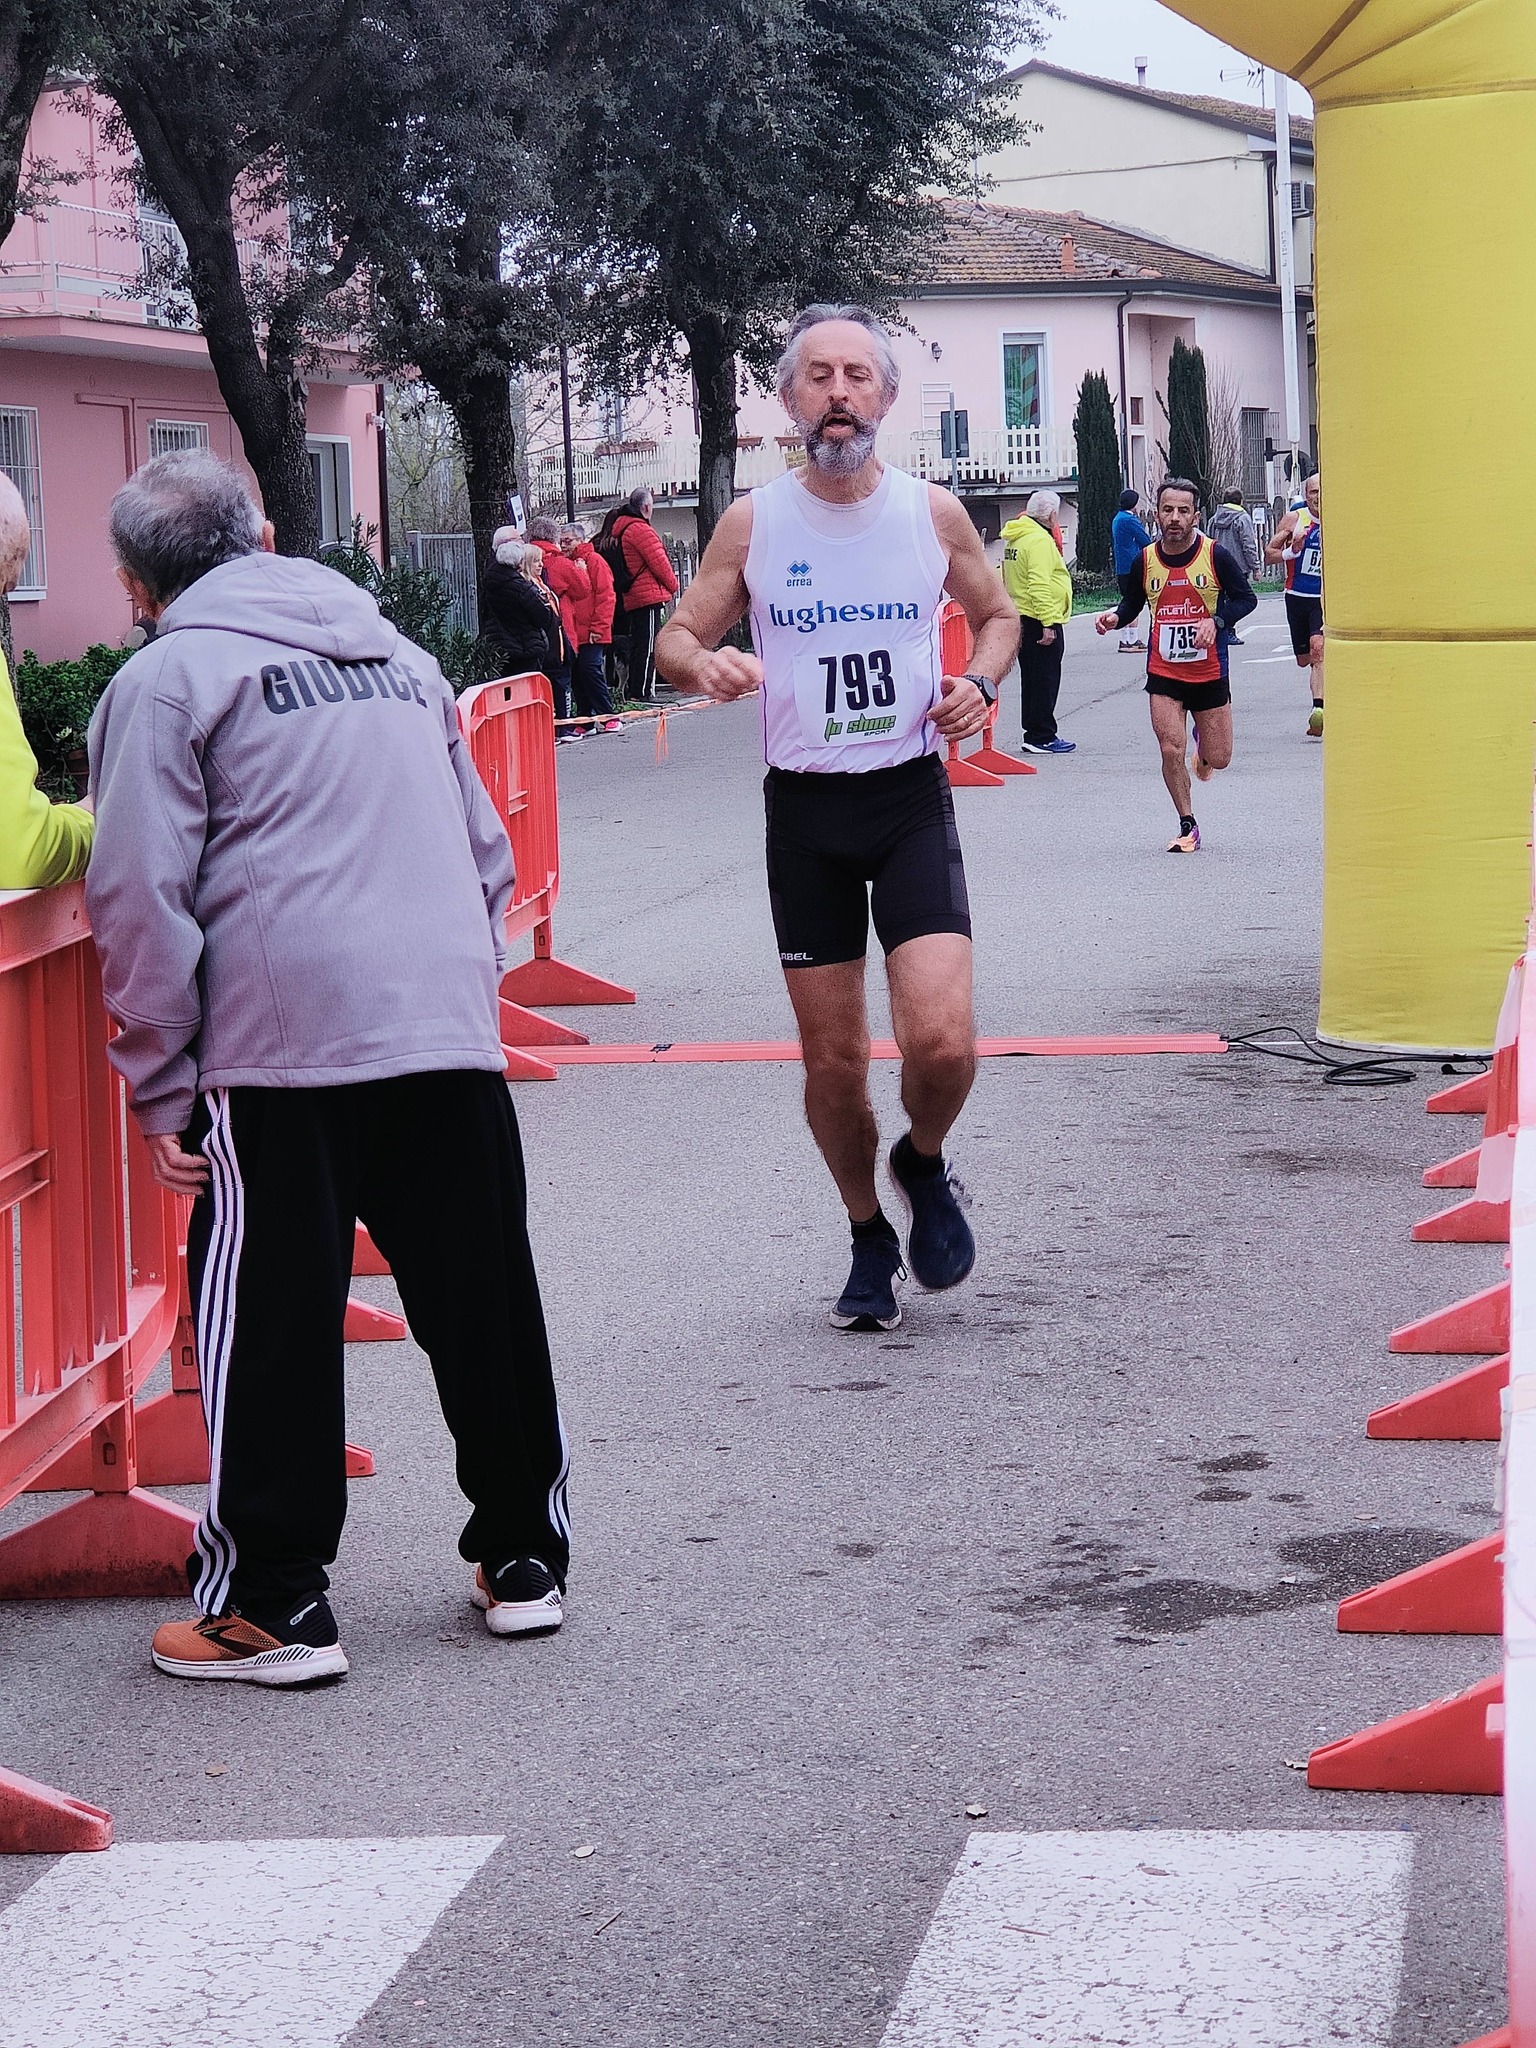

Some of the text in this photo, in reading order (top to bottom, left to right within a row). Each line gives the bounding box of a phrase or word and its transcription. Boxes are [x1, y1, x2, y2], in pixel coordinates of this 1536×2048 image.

[769, 600, 919, 633] lughesina
[261, 658, 428, 714] GIUDICE
[818, 650, 896, 714] 793
